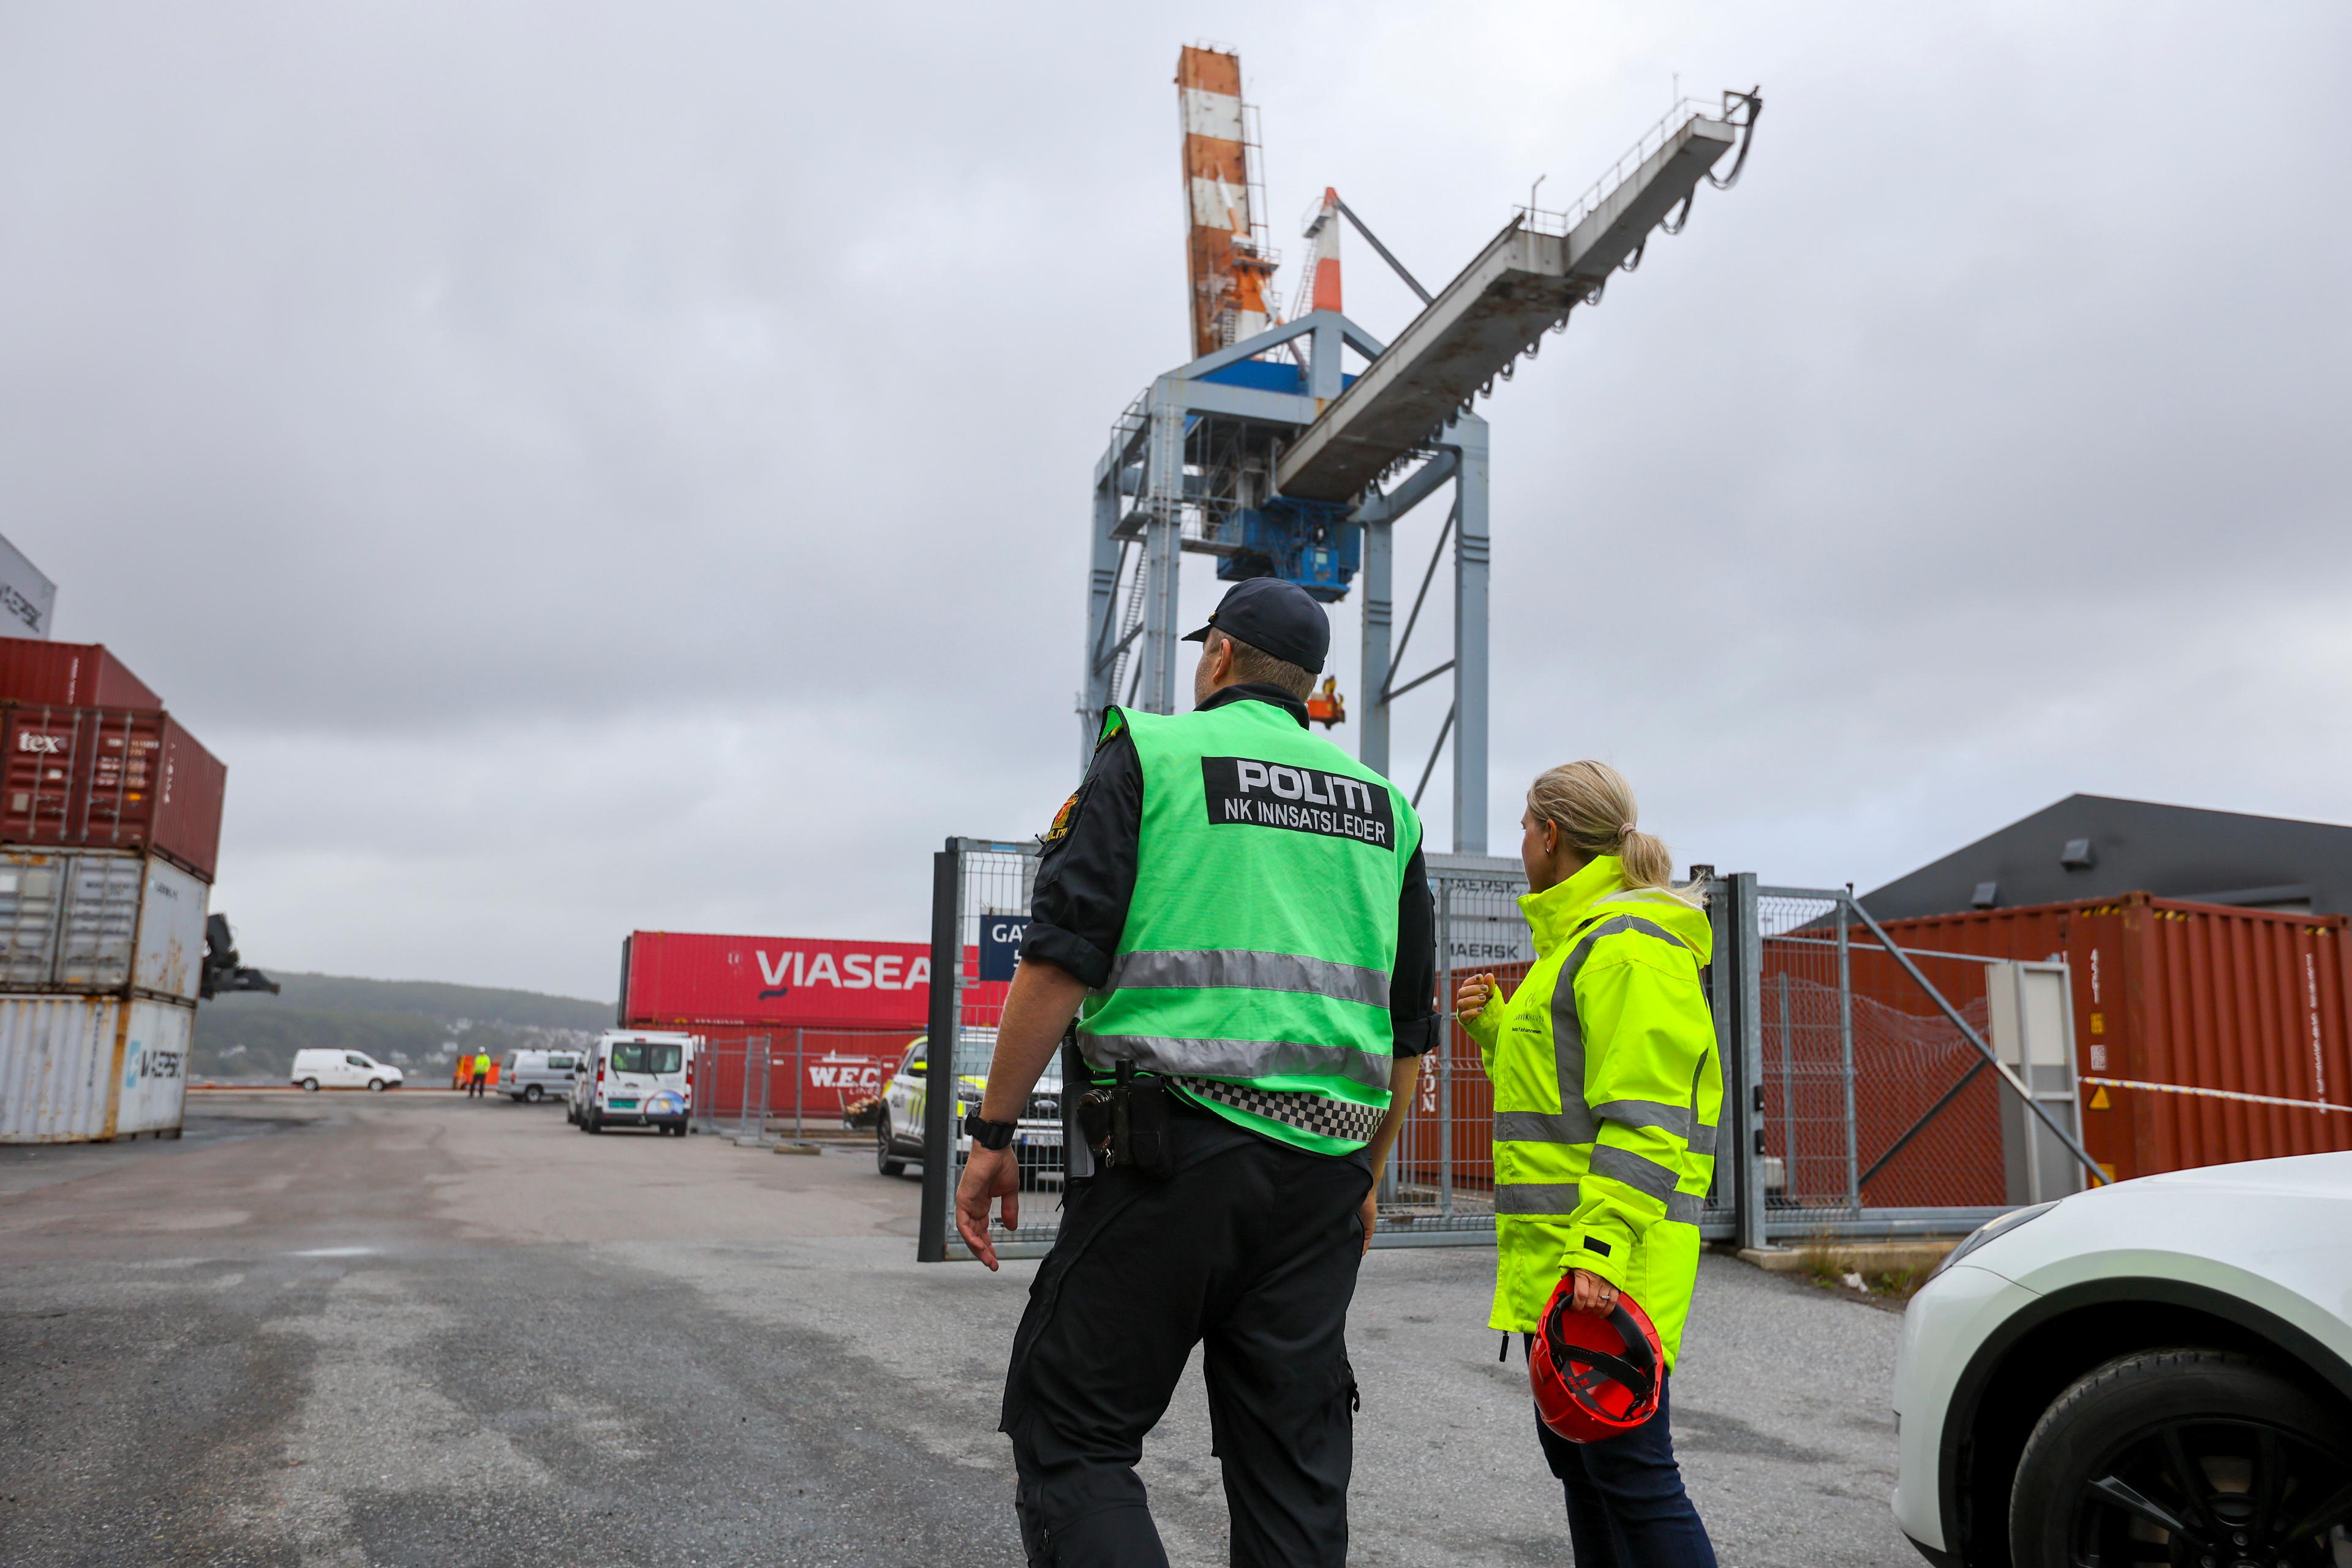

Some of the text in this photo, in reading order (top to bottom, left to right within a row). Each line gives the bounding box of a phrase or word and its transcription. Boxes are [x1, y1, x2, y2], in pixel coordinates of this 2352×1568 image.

[18, 732, 60, 753] tex
[1236, 760, 1372, 814] POLITI
[1224, 798, 1385, 844] NK INNSATSLEDER
[755, 950, 931, 990] VIASEA
